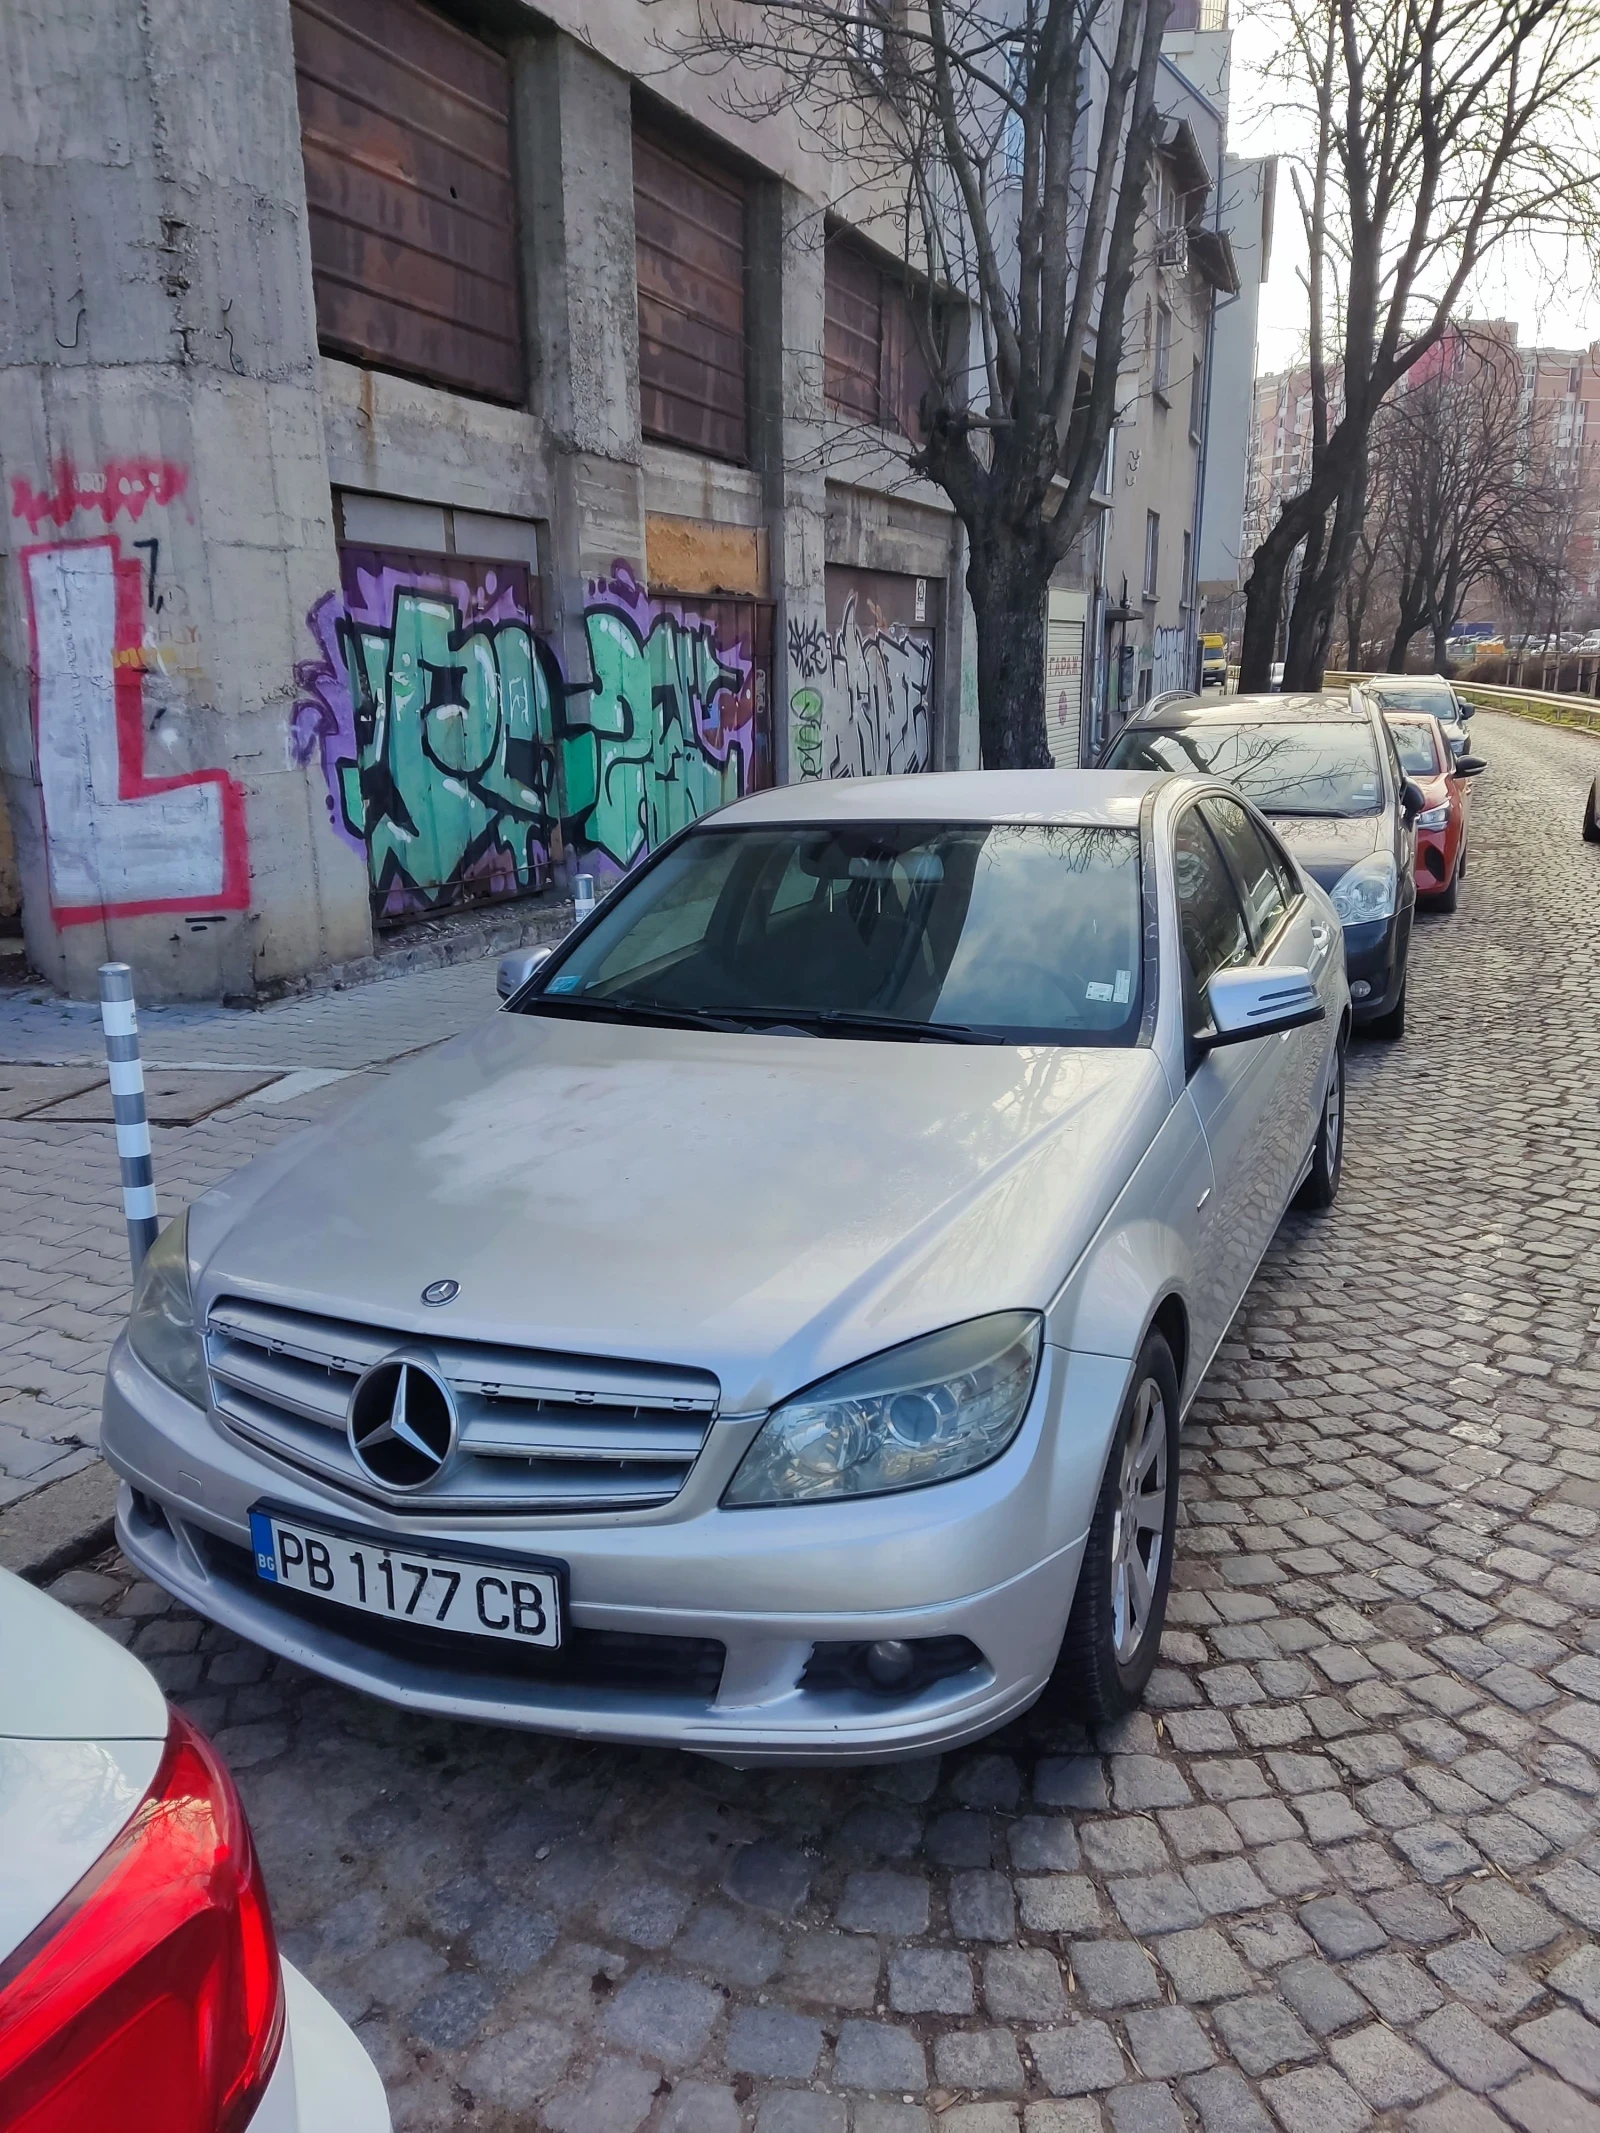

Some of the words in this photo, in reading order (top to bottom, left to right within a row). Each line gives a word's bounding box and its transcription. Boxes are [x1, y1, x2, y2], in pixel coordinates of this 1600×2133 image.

[1049, 656, 1079, 676] ГАРАЖ
[257, 1552, 276, 1572] BG
[277, 1529, 334, 1591] PB
[349, 1551, 461, 1621] 1177
[475, 1575, 547, 1637] CB
